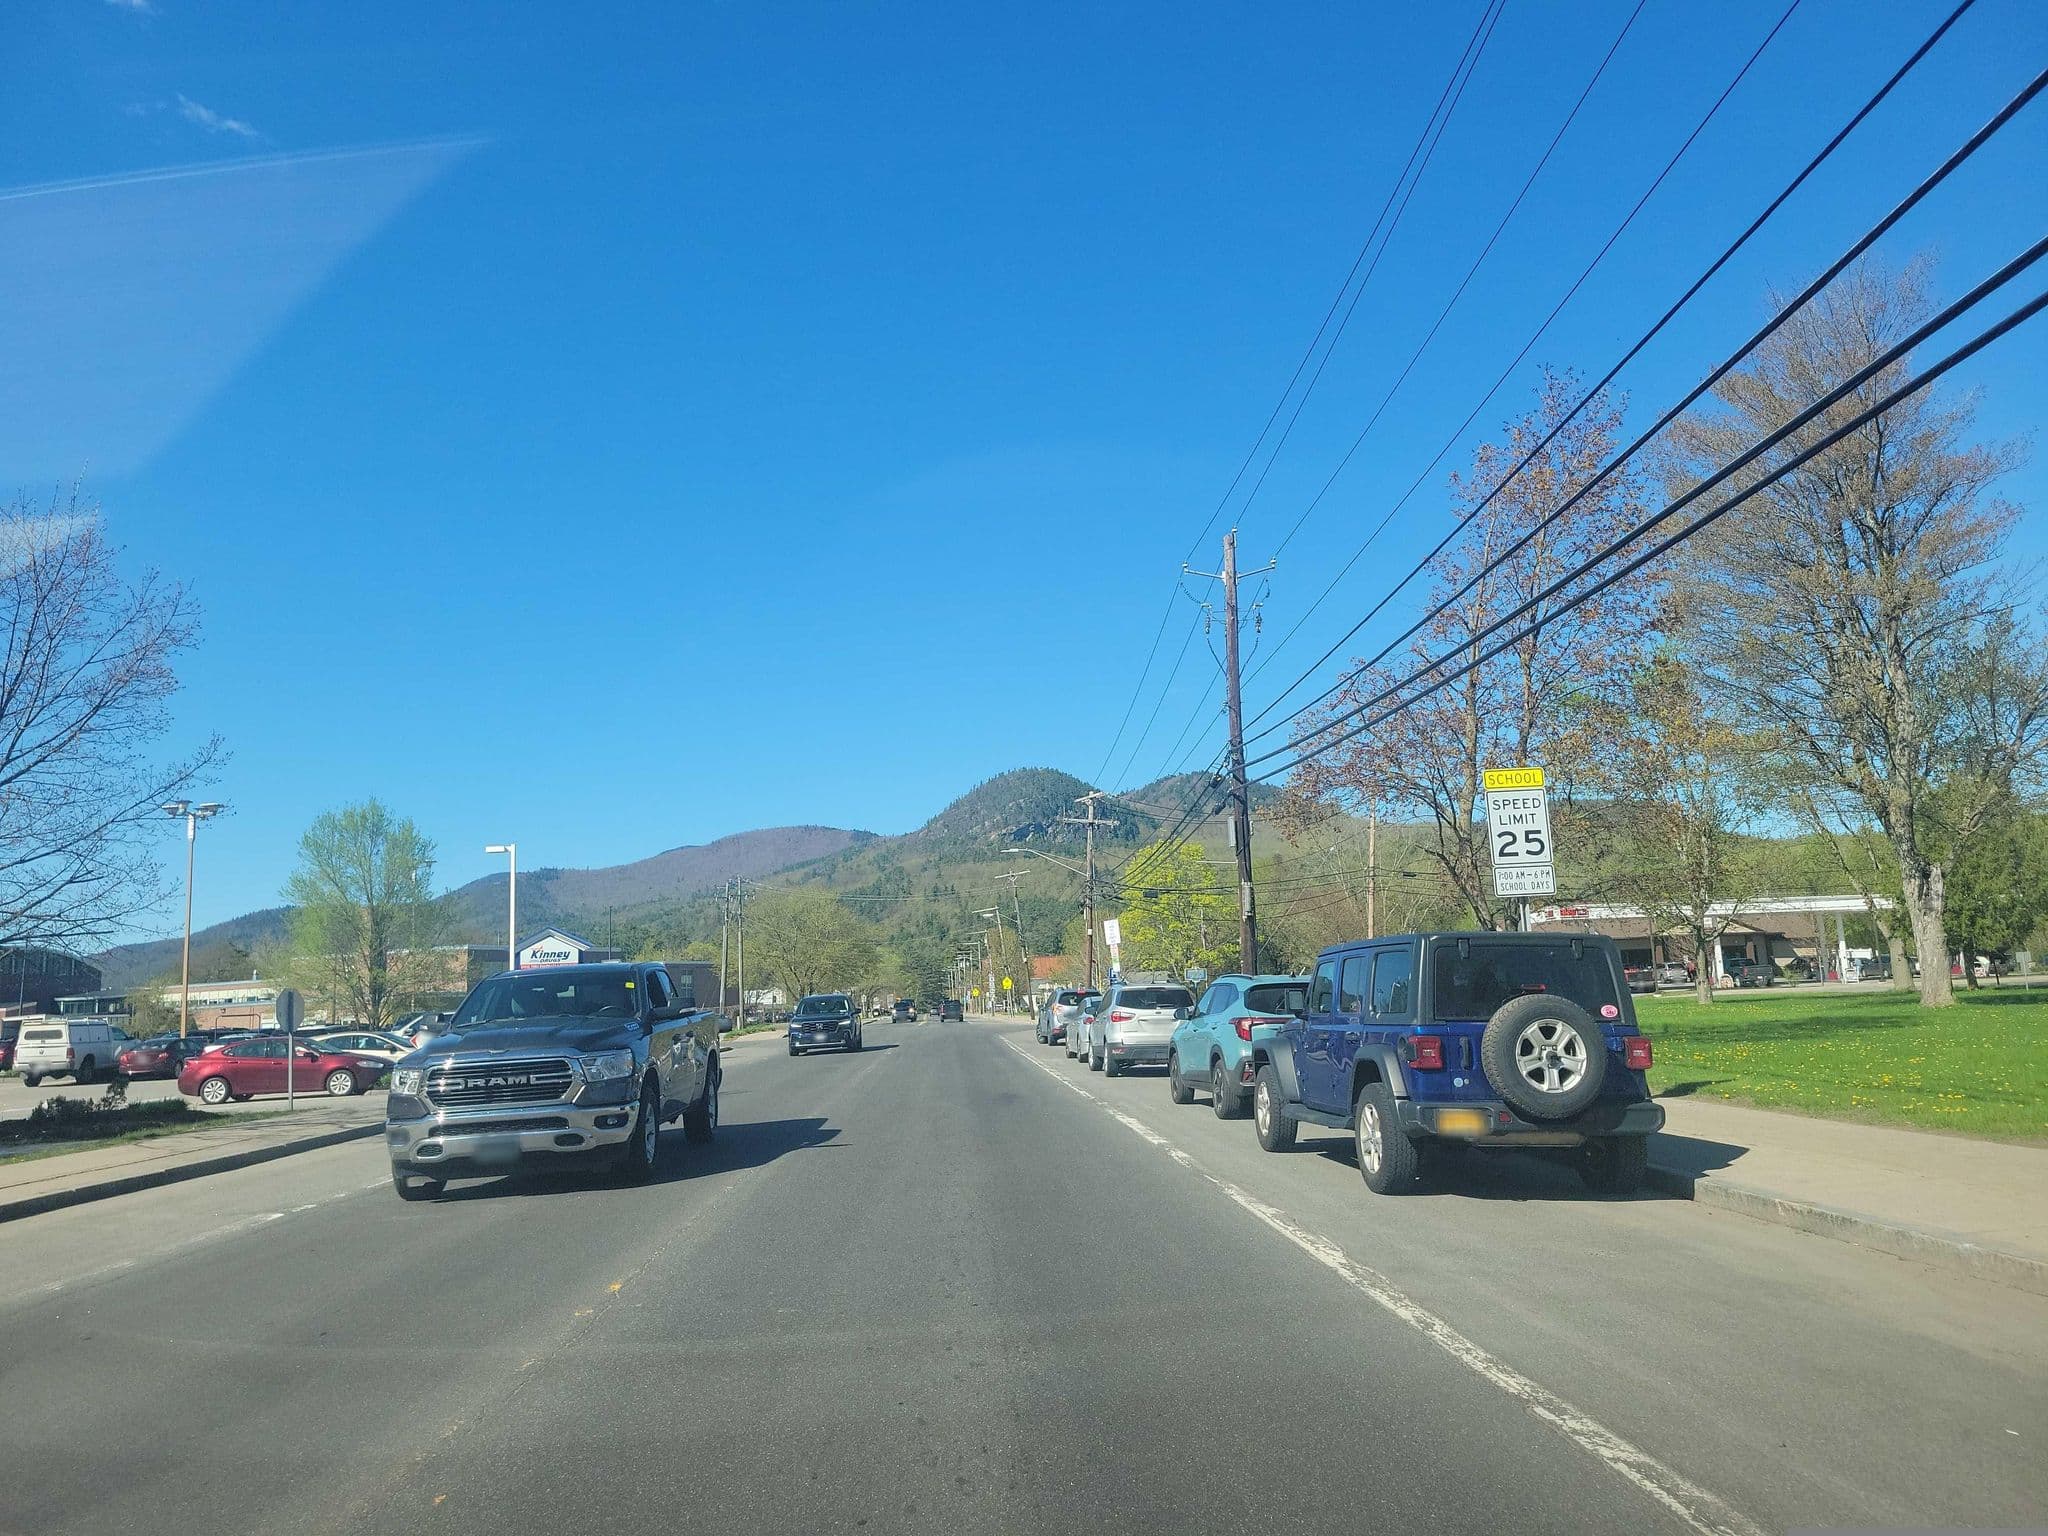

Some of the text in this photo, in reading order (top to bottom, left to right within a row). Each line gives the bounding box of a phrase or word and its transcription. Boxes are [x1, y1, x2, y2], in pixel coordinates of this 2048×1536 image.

[1488, 773, 1540, 785] SCHOOL
[1492, 798, 1541, 810] SPEED
[1499, 813, 1536, 826] LIMIT
[1497, 830, 1545, 857] 25
[1516, 871, 1525, 879] AM
[1534, 870, 1539, 878] 6
[1541, 870, 1550, 878] PM
[1500, 881, 1550, 891] SCHOOL DAYS
[530, 949, 570, 960] Kinney
[467, 1076, 527, 1088] RAM
